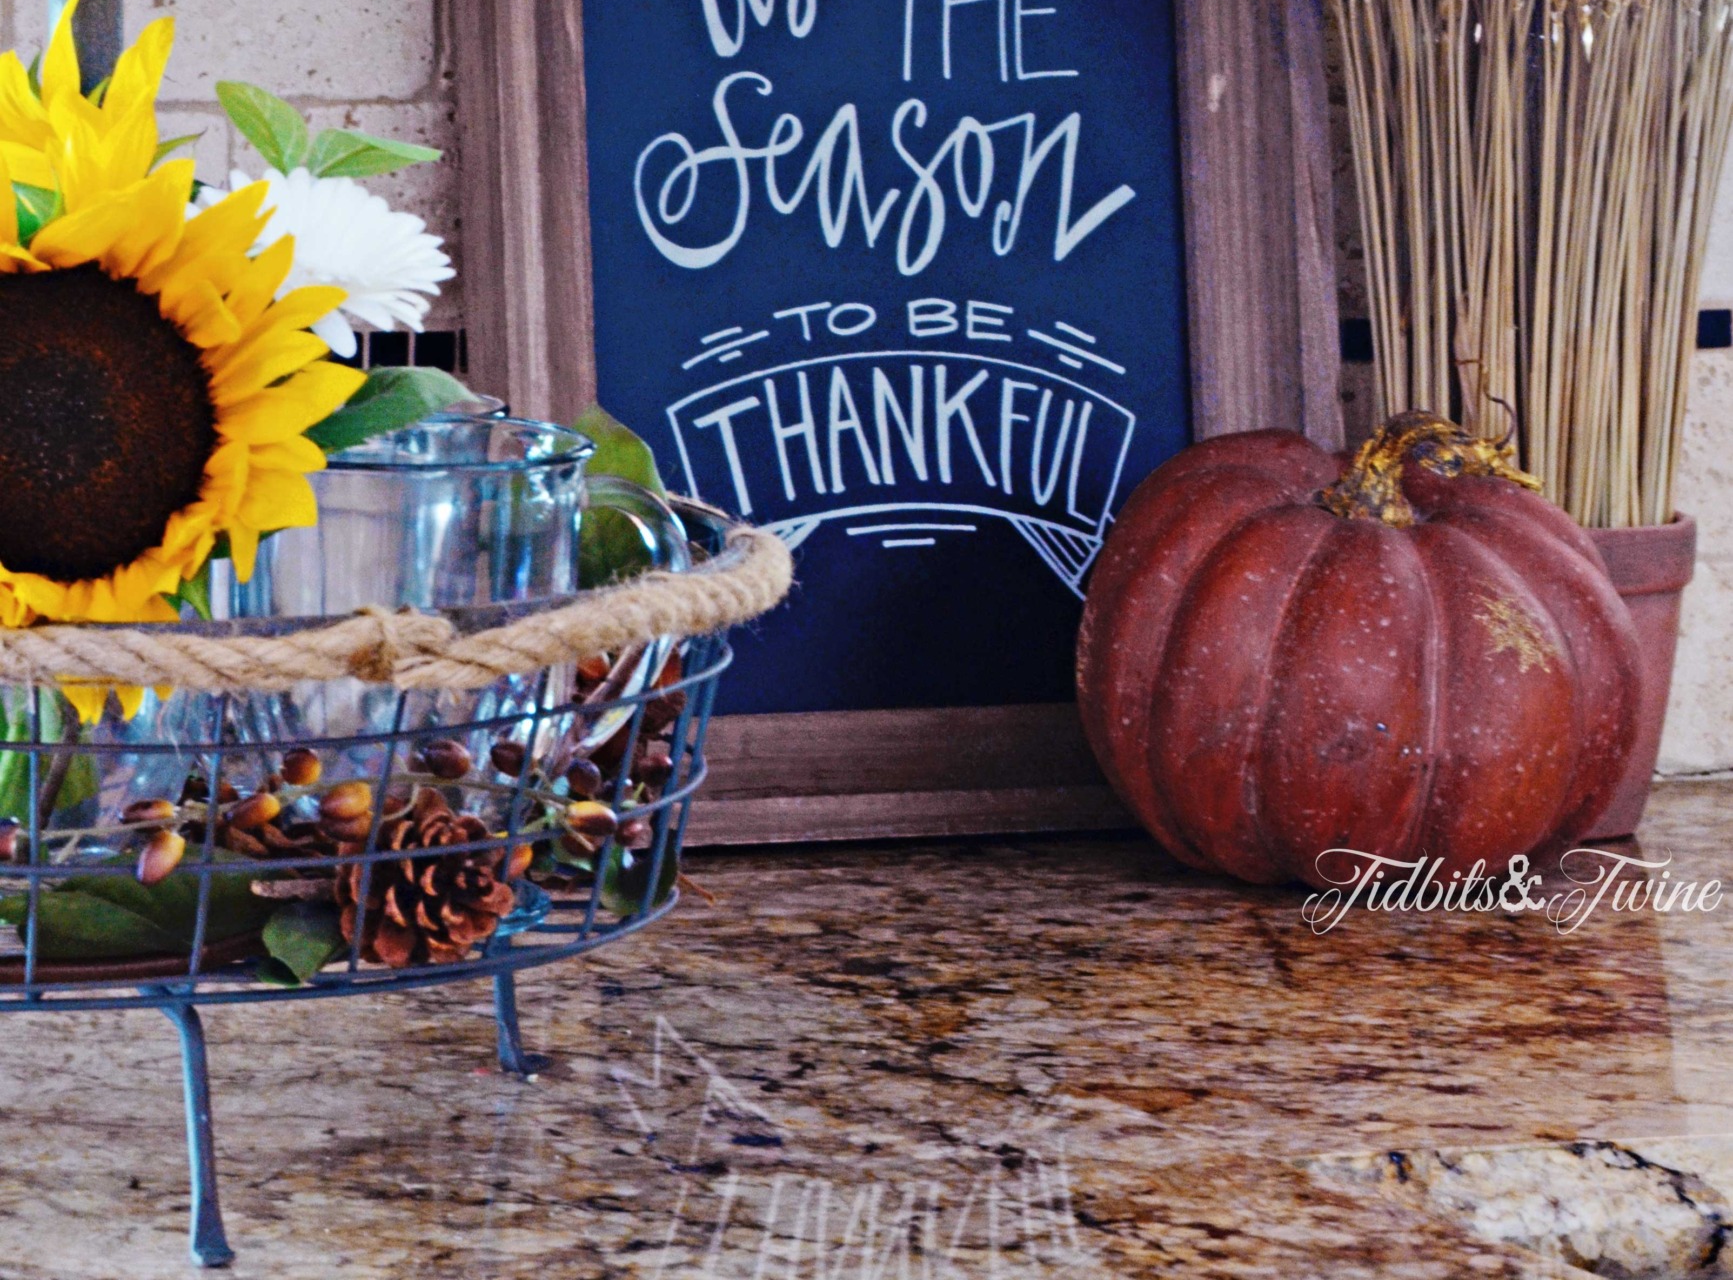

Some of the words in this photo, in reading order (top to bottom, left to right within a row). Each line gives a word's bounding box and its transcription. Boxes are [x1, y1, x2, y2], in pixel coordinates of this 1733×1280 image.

[634, 71, 1136, 276] Season
[773, 301, 877, 341] TO
[907, 297, 1014, 342] BE
[693, 364, 1097, 526] THANKFUL
